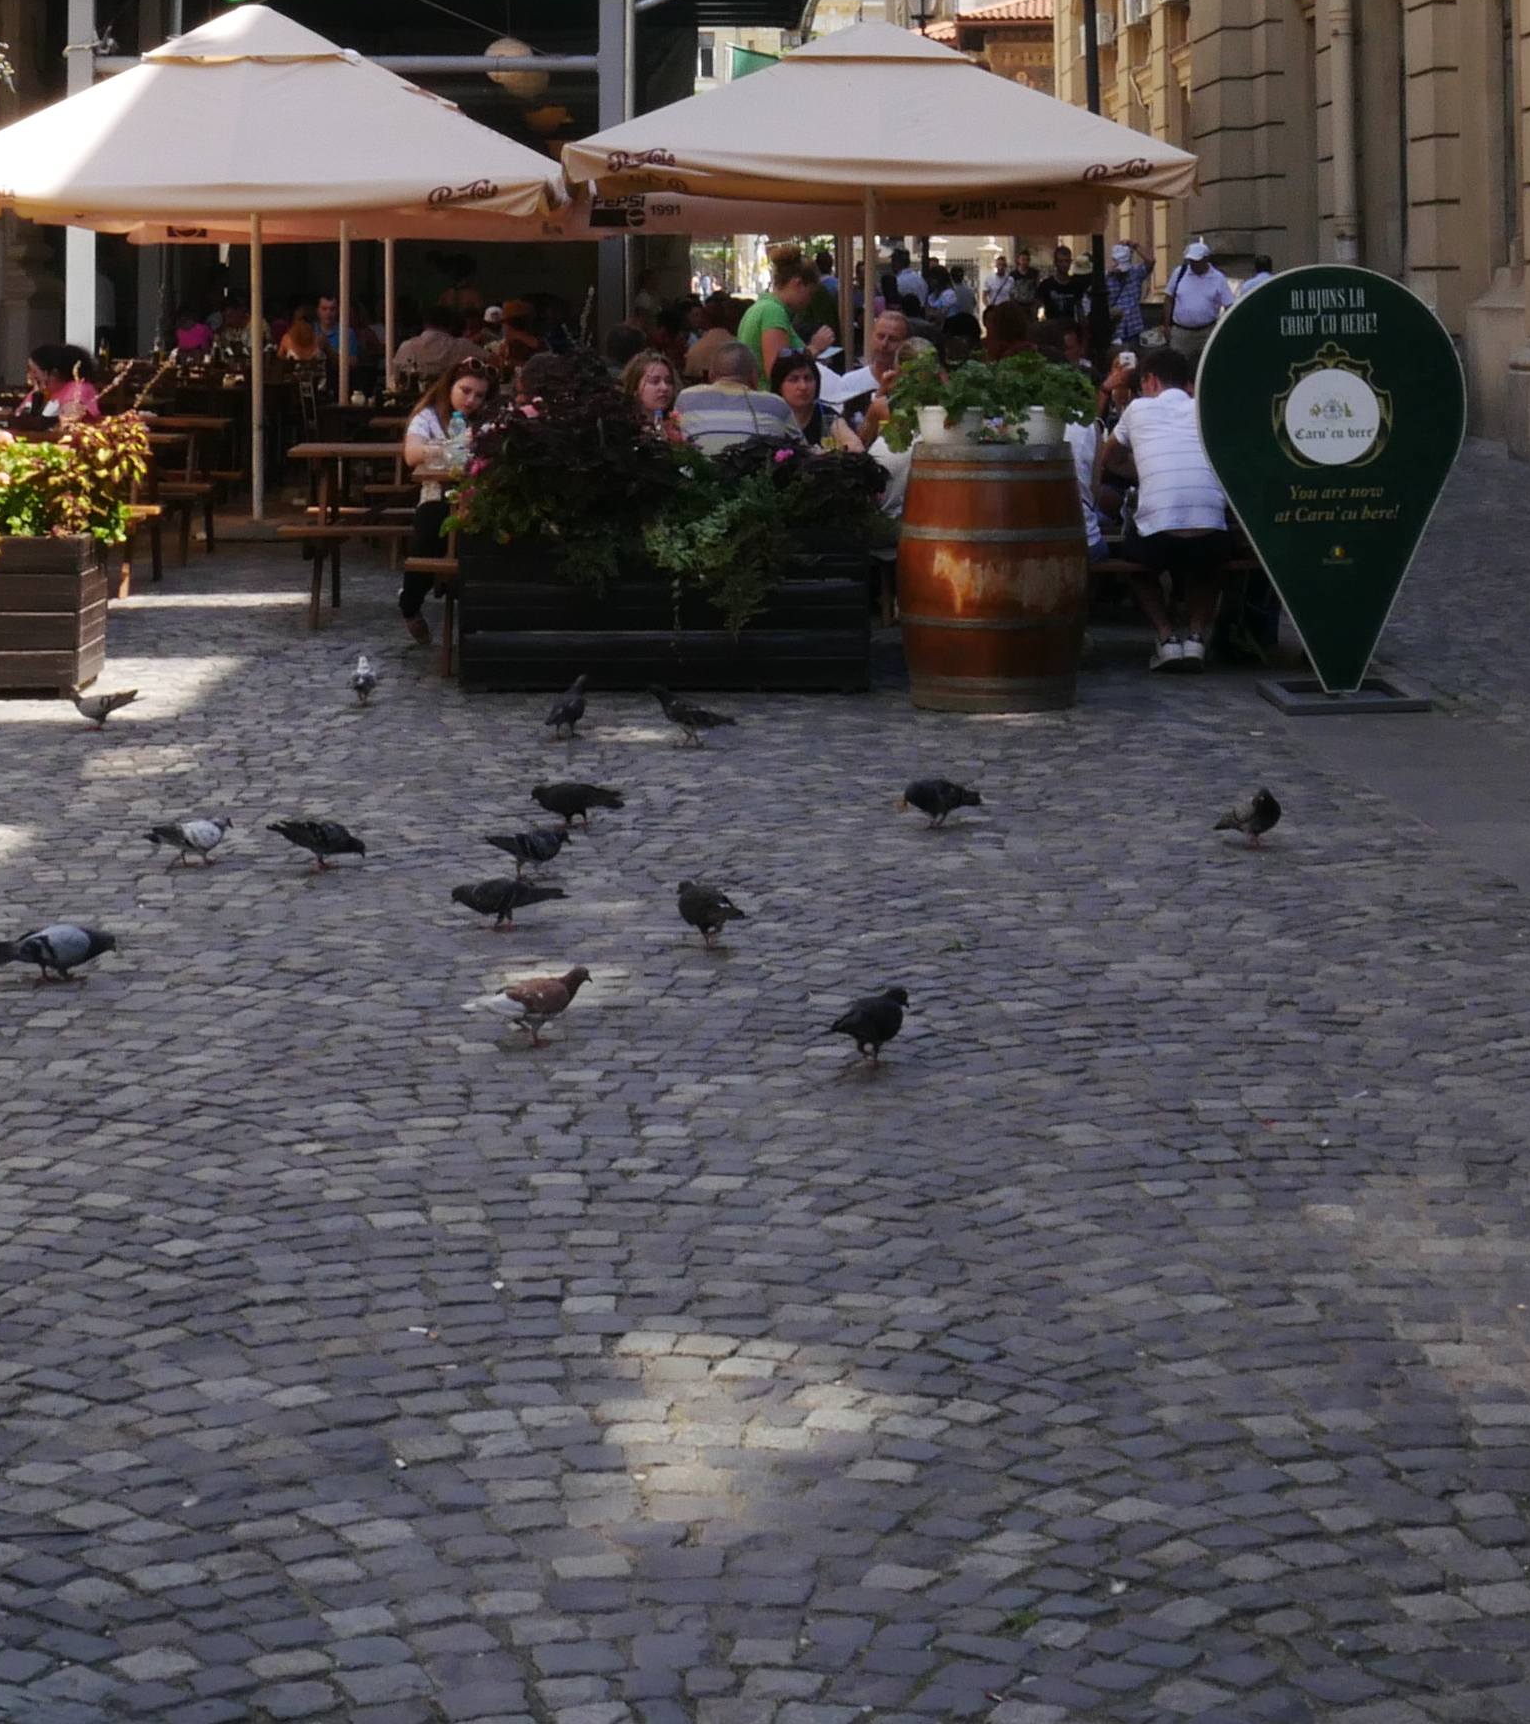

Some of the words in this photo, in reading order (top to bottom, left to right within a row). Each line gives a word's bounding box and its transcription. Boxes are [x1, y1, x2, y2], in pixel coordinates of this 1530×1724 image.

[591, 194, 646, 208] PEPSI
[649, 203, 682, 217] 1991
[1320, 313, 1337, 336] CU
[1331, 430, 1344, 440] cu
[1289, 484, 1318, 501] You
[1321, 487, 1347, 500] are
[1349, 486, 1384, 499] now
[1274, 508, 1291, 523] at
[1340, 510, 1358, 521] cu
